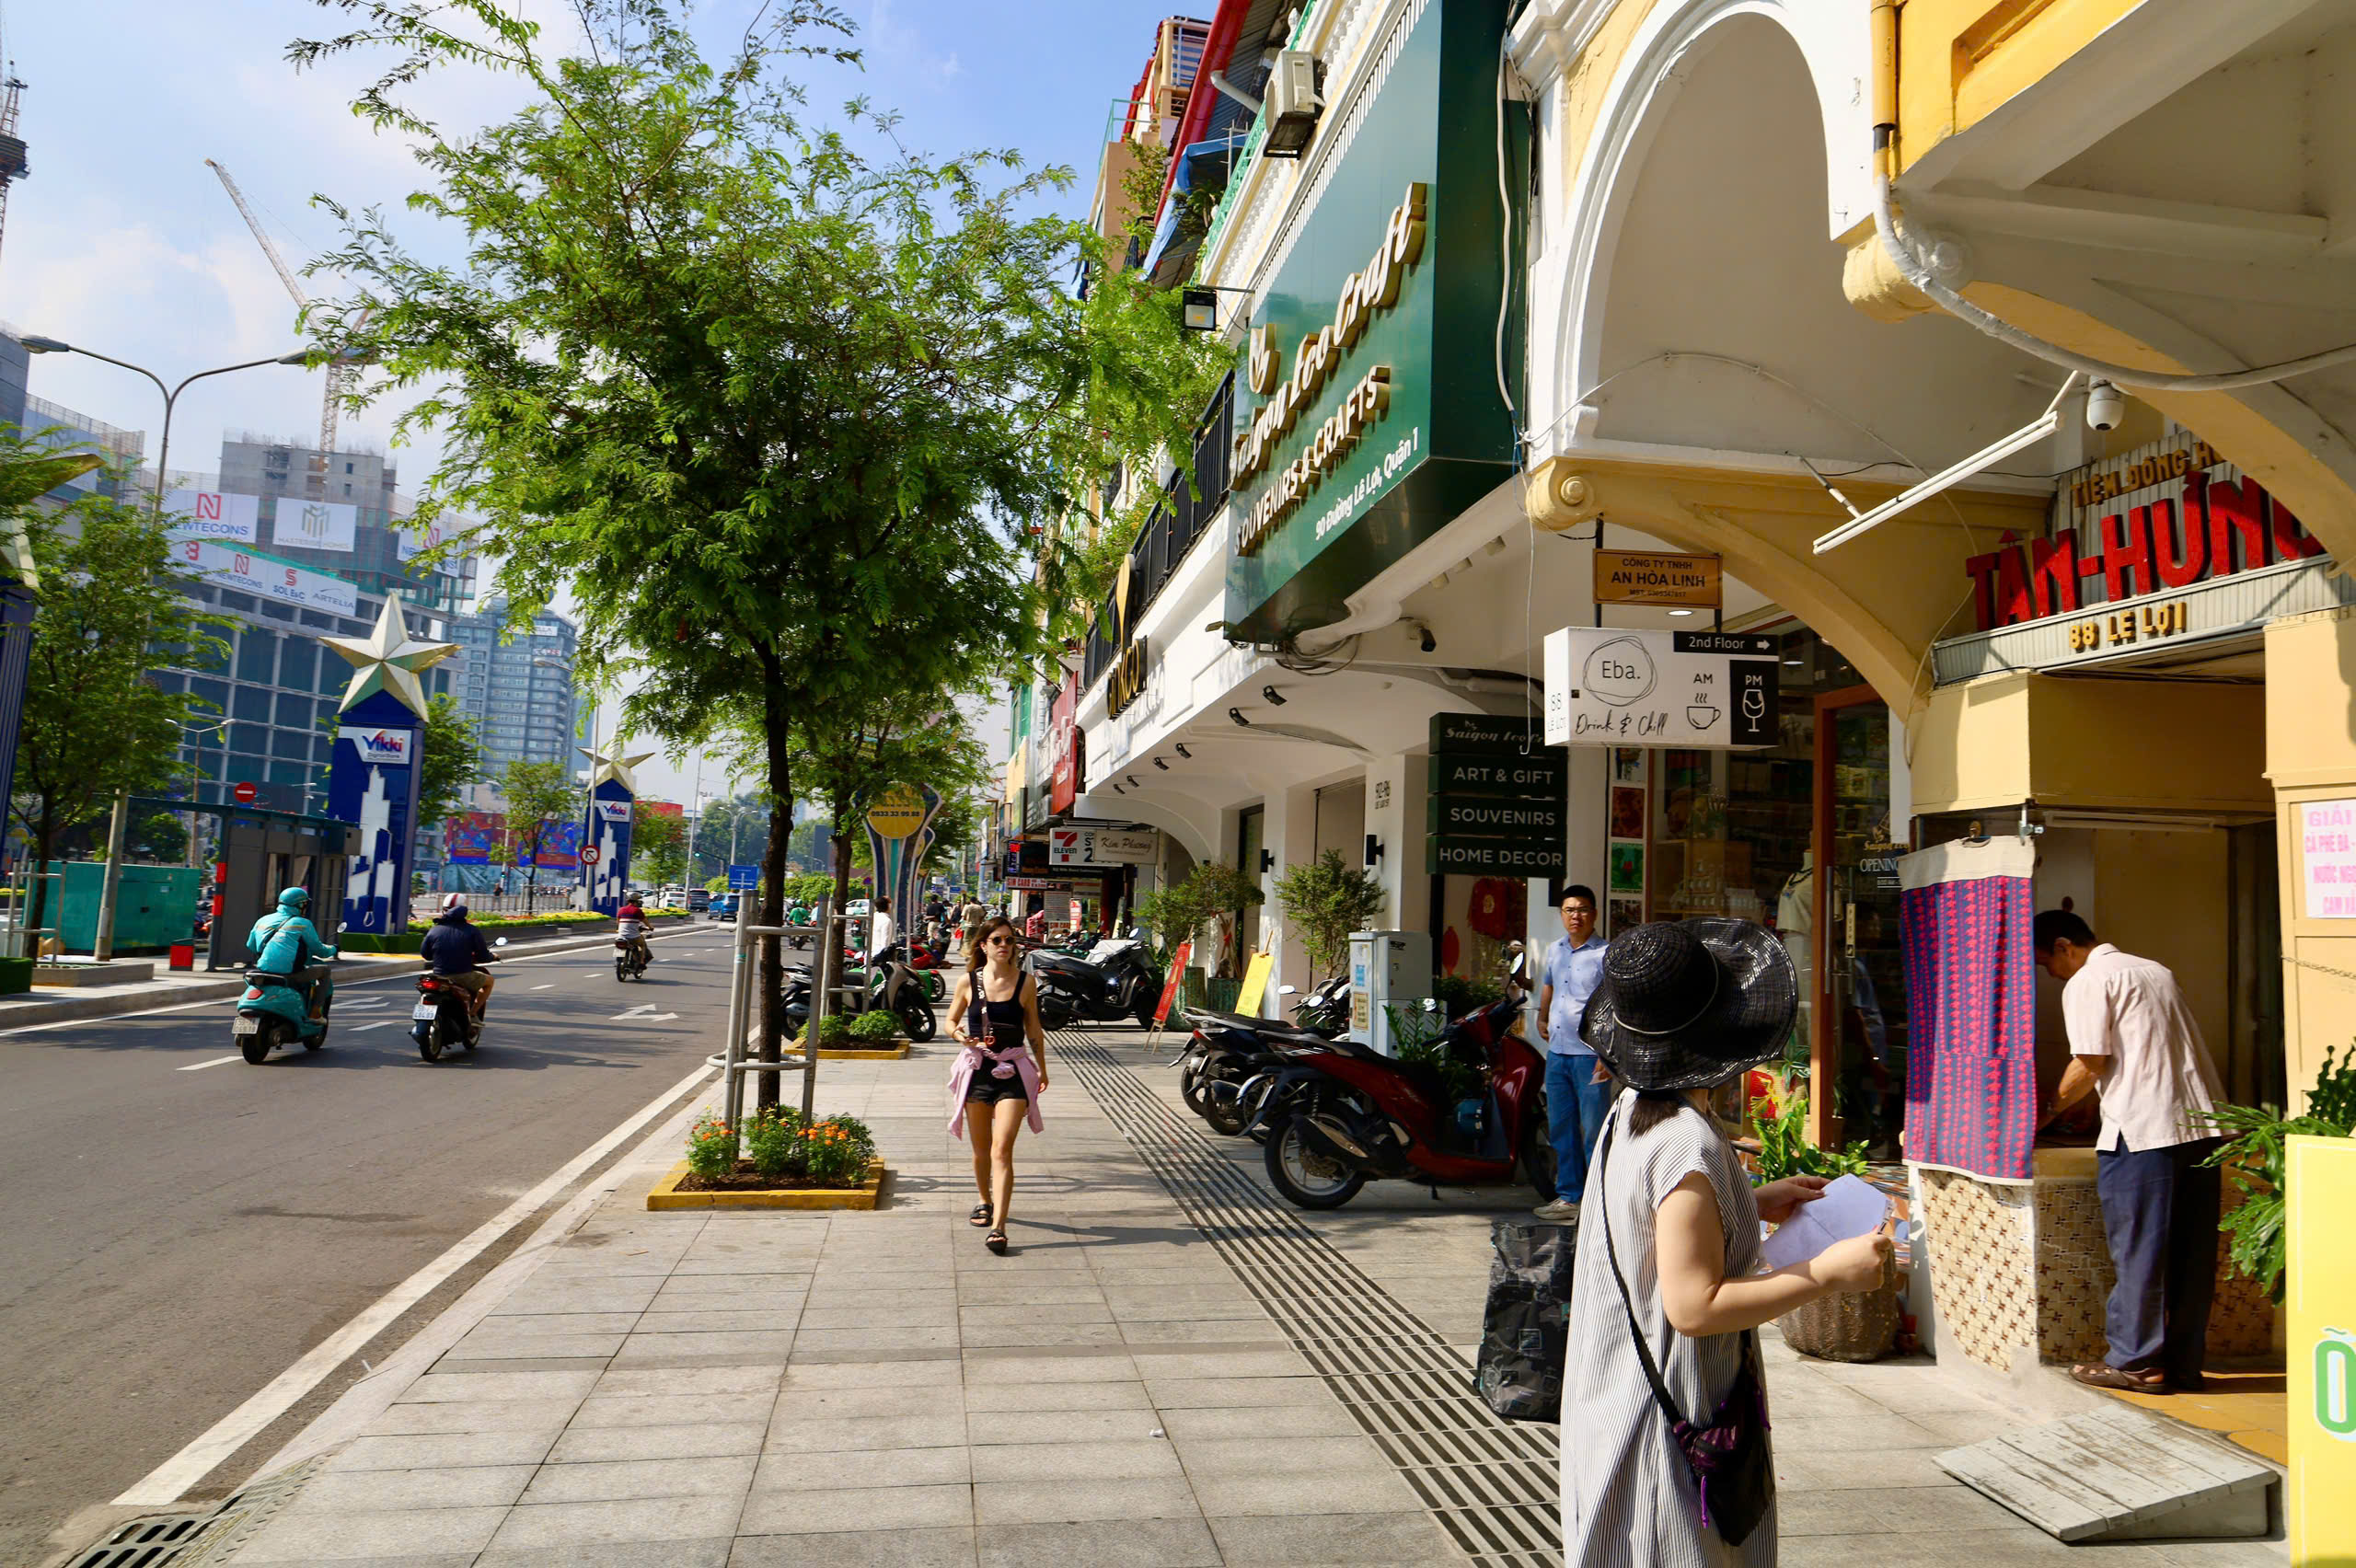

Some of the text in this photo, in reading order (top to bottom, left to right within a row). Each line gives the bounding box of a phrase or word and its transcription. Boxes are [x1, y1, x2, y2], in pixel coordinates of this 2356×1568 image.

[1230, 182, 1422, 490] Saigon Eco Craft
[1234, 366, 1383, 556] SOUVENIRS & CRAFTS
[1315, 519, 1326, 541] 90
[1353, 480, 1366, 508] Lê
[1383, 438, 1411, 478] Quận
[1412, 427, 1419, 452] 1
[175, 521, 248, 536] EWTECONS
[1623, 557, 1692, 570] CÔNG TY TNHH
[1611, 570, 1705, 587] AN HÒA LINH
[272, 584, 289, 597] SOL
[312, 592, 355, 609] ARTELIA
[1688, 636, 1745, 650] 2nd Floor
[2069, 621, 2099, 649] 88
[1601, 661, 1641, 680] Eba.
[1693, 674, 1714, 685] AM
[1745, 674, 1762, 686] PM
[1575, 709, 1615, 735] Drink
[1637, 711, 1669, 737] Chill
[362, 729, 405, 752] Vikki
[1445, 728, 1497, 742] Saigon
[1453, 767, 1554, 785] ART & GIFT
[1450, 807, 1555, 826] SOUVENIRS
[1101, 837, 1118, 848] Kim
[1439, 847, 1563, 866] HOME DECOR
[1007, 878, 1016, 887] SIM
[1017, 879, 1031, 888] CARD
